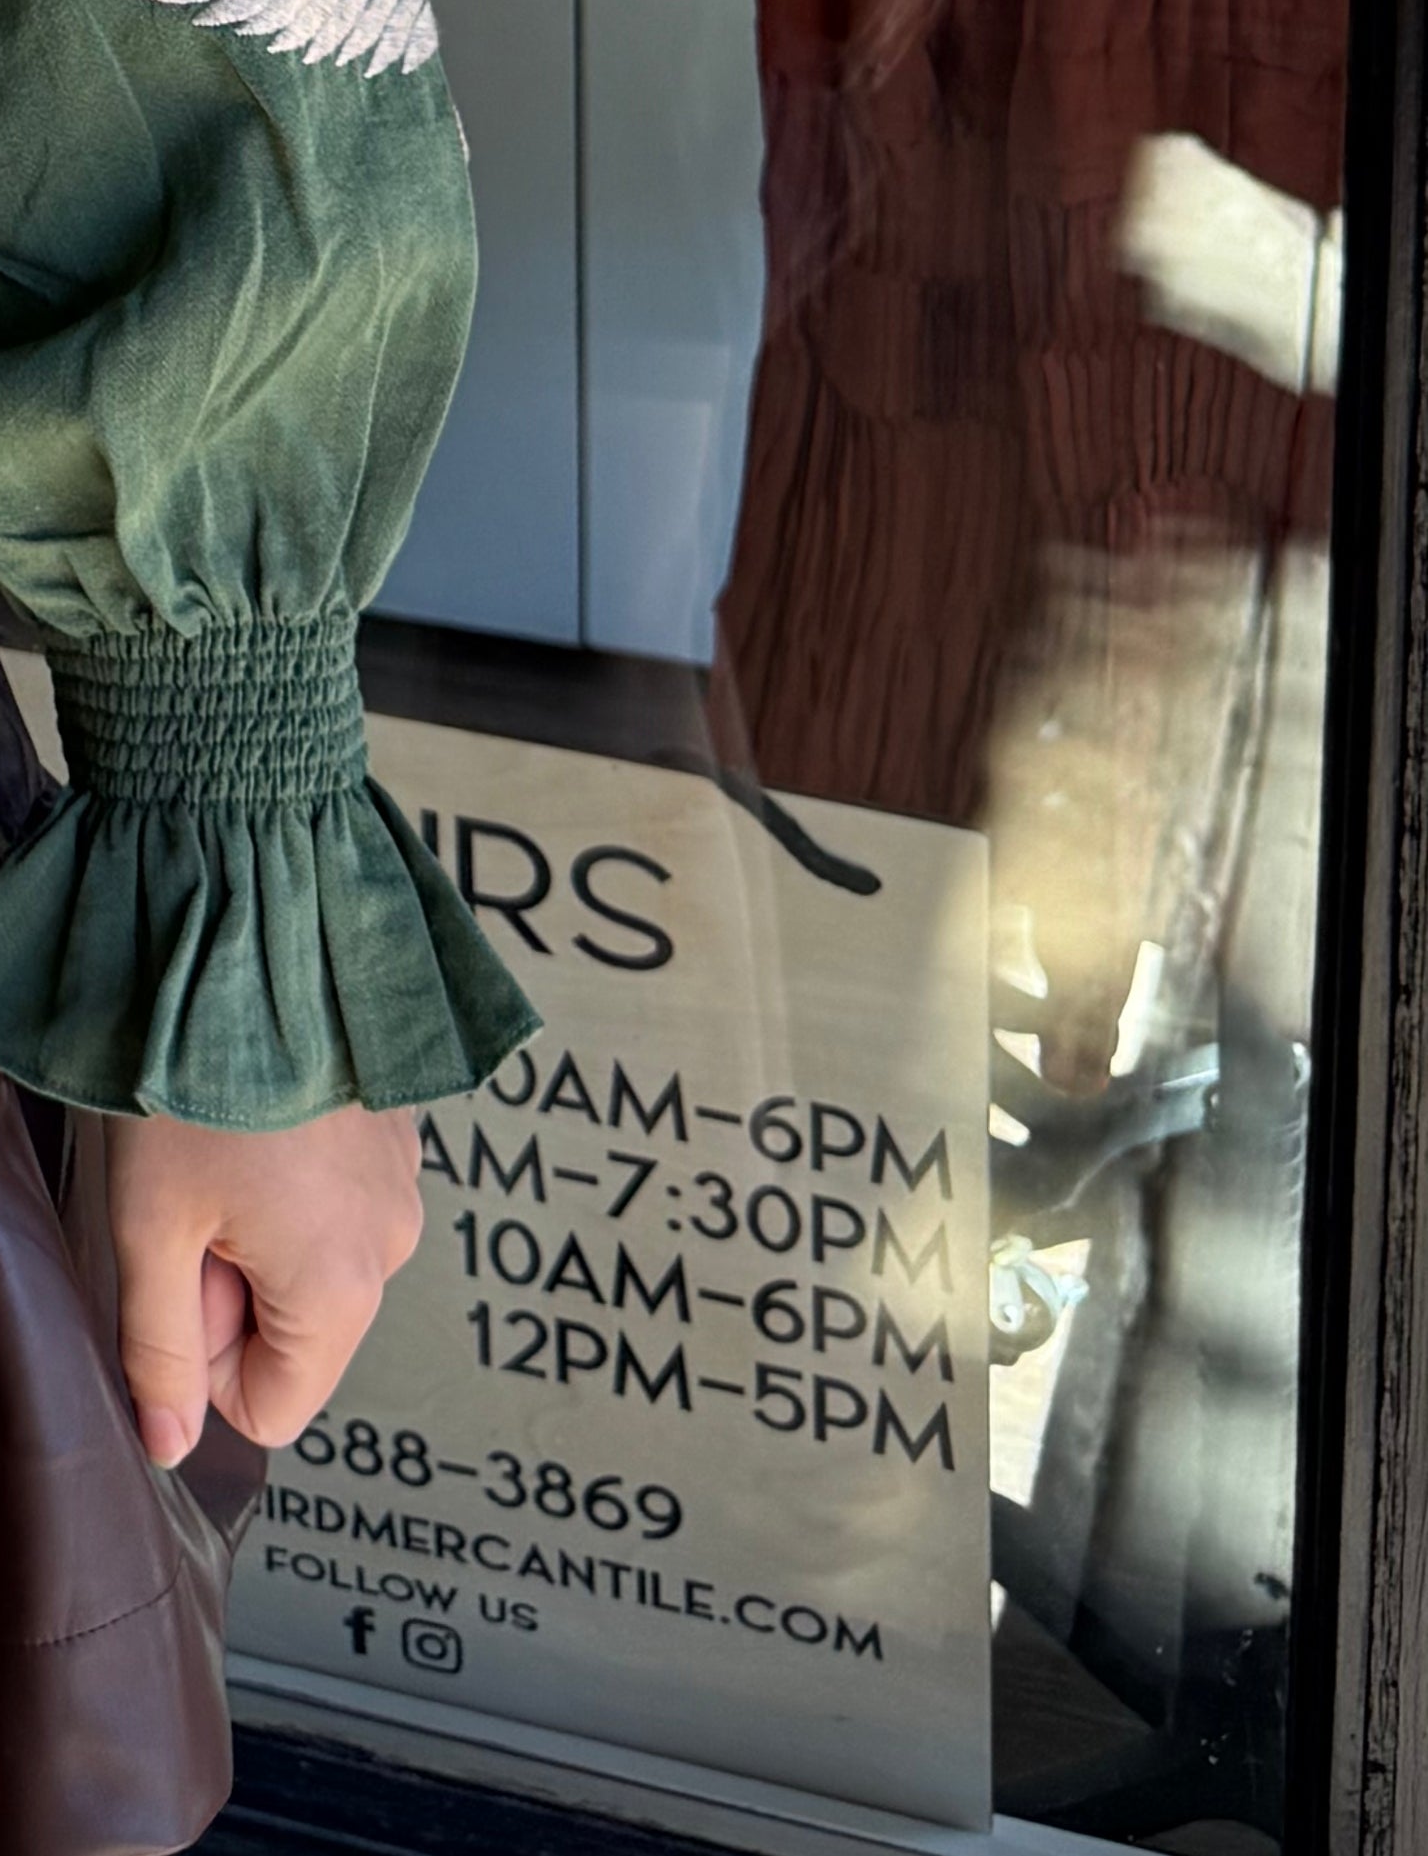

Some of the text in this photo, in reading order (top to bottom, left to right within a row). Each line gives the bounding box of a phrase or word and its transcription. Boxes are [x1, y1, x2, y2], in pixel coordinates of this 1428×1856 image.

[466, 1048, 953, 1200] 0AM-6PM
[453, 1210, 955, 1383] 10AM-6PM
[467, 1300, 956, 1472] 12PM-5PM
[293, 1411, 683, 1540] 688-3869
[254, 1483, 884, 1662] IRDMERCANTILE.COM
[264, 1544, 539, 1632] FOLLOW US
